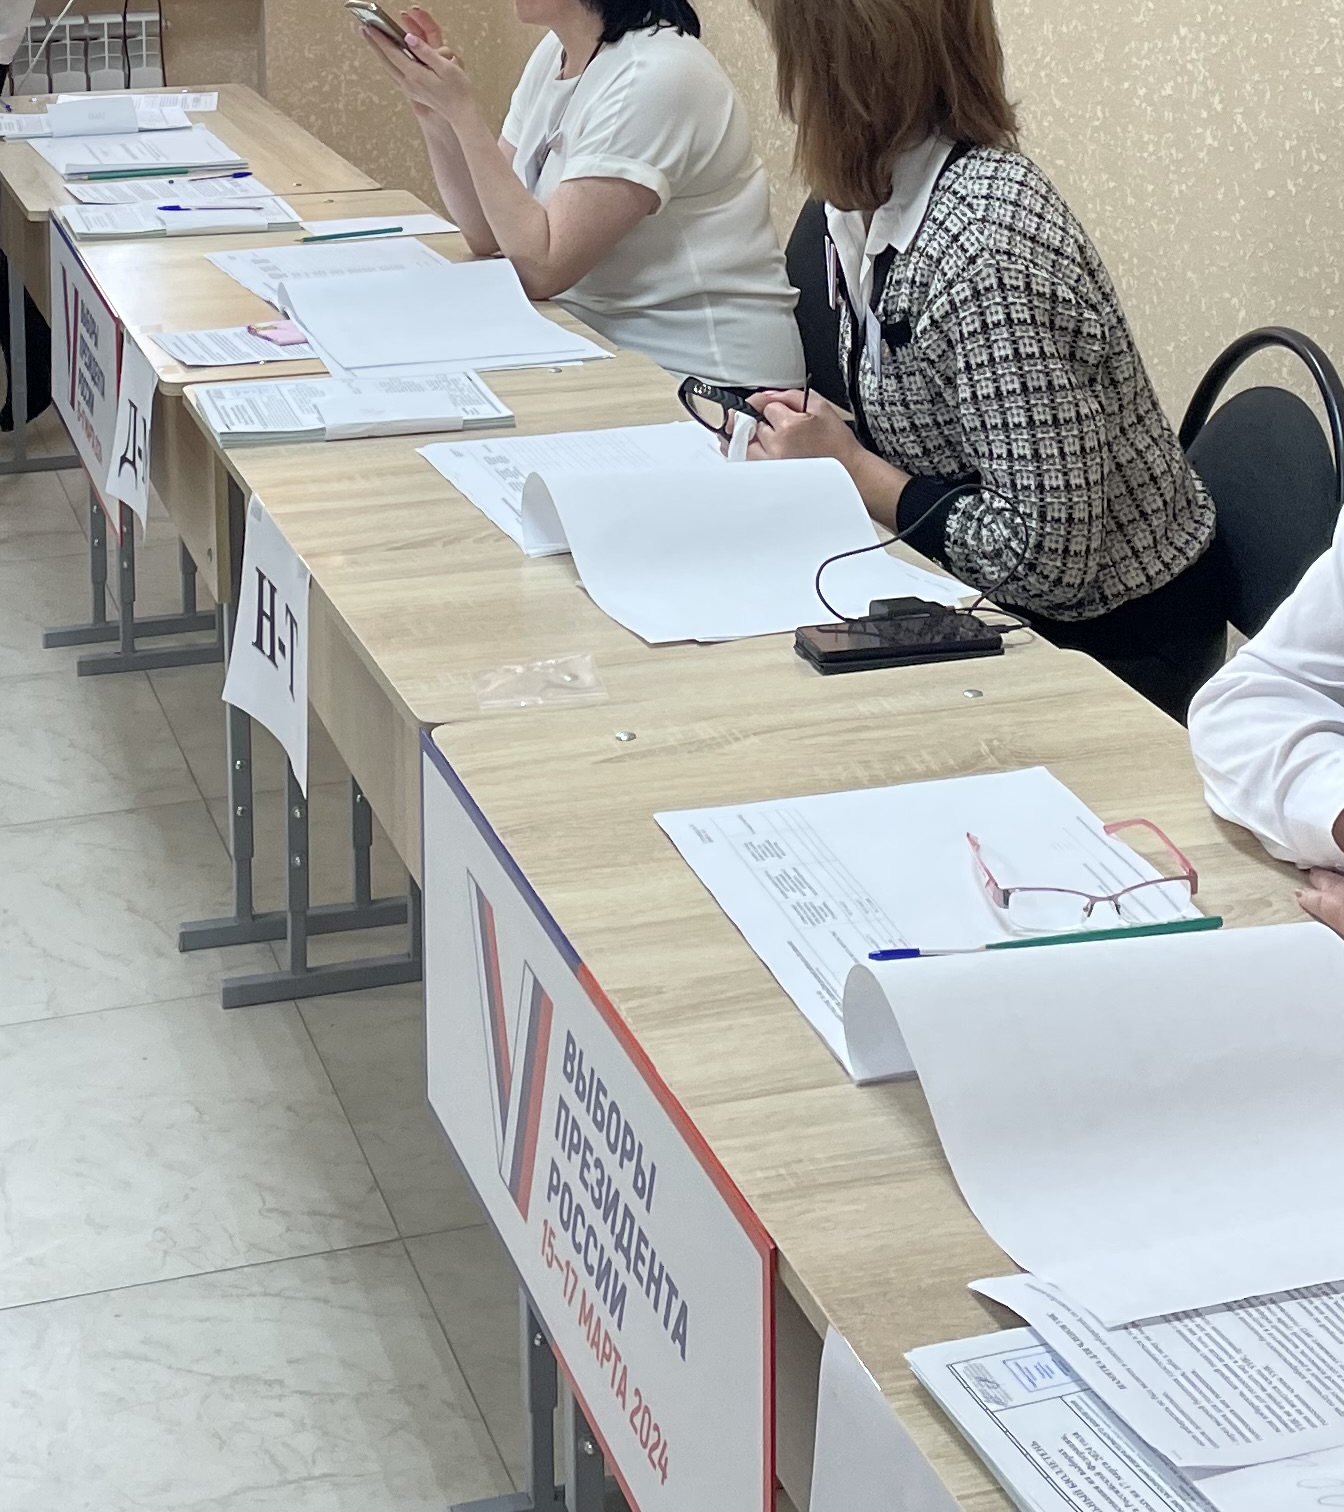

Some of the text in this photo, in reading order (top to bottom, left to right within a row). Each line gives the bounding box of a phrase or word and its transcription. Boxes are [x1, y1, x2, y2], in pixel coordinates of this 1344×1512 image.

[118, 398, 147, 490] Д-
[562, 1028, 658, 1216] ВЫБОРЫ
[546, 1157, 629, 1333] РОССИИ
[553, 1093, 691, 1362] ПРЕЗИДЕНТА
[576, 1287, 630, 1413] МАРТА
[628, 1386, 672, 1488] 2024
